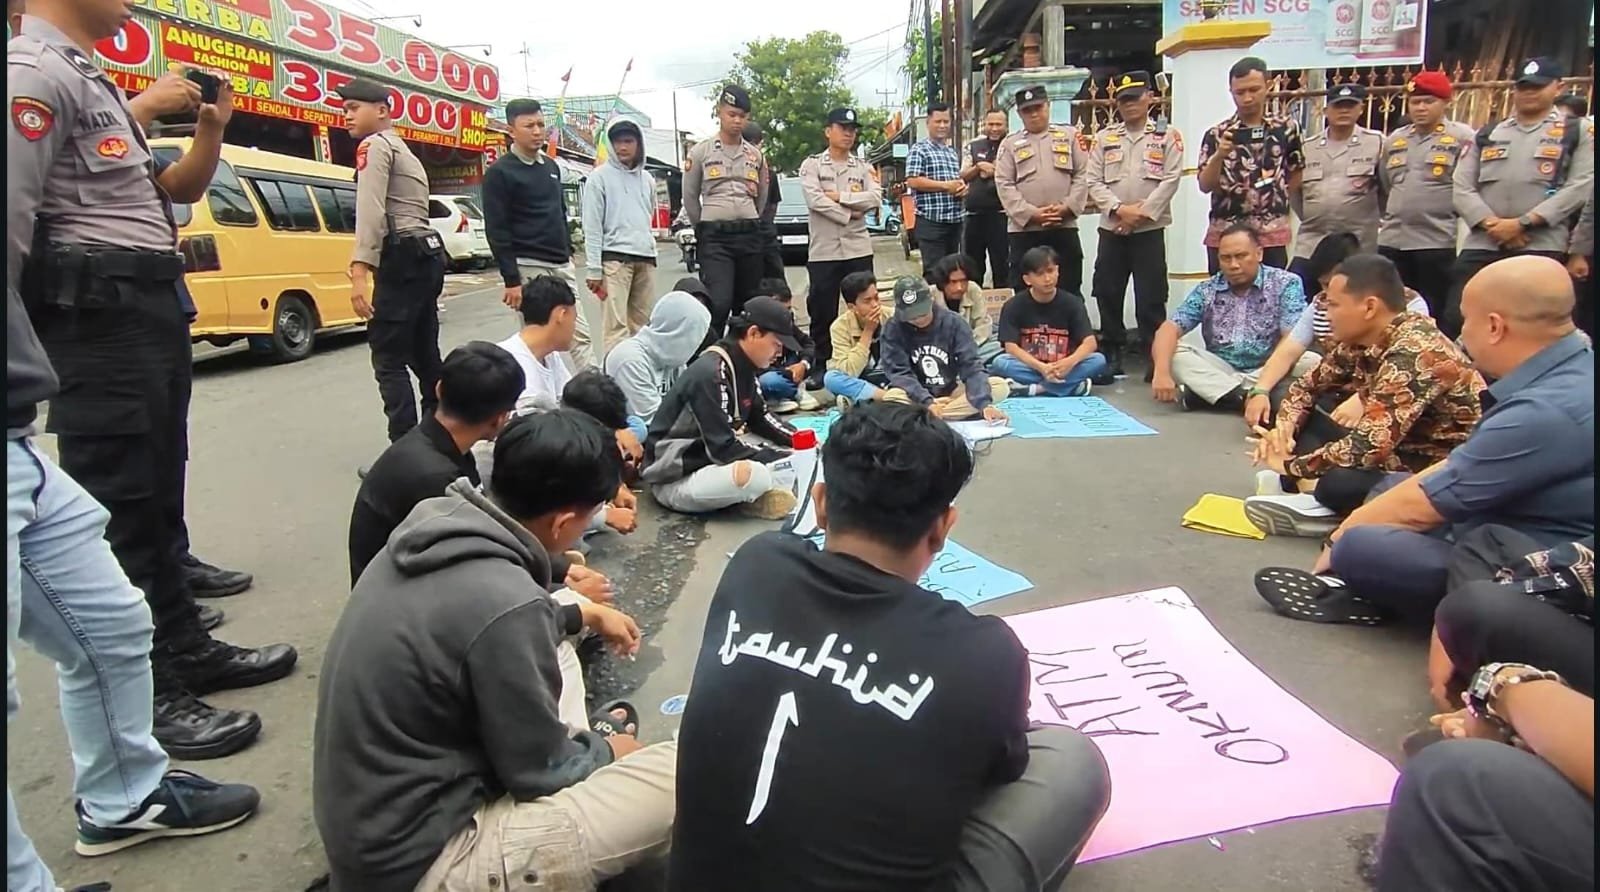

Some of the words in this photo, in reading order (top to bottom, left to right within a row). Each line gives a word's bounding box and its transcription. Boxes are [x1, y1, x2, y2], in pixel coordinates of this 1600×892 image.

[1264, 0, 1310, 14] SCG
[166, 26, 272, 67] ANUGERAH
[193, 52, 250, 75] FASHION
[287, 0, 499, 100] 35.000
[256, 101, 293, 118] SENDAL
[303, 110, 334, 125] SEPATU
[1028, 647, 1160, 737] ATM
[1113, 639, 1290, 765] OKNUM
